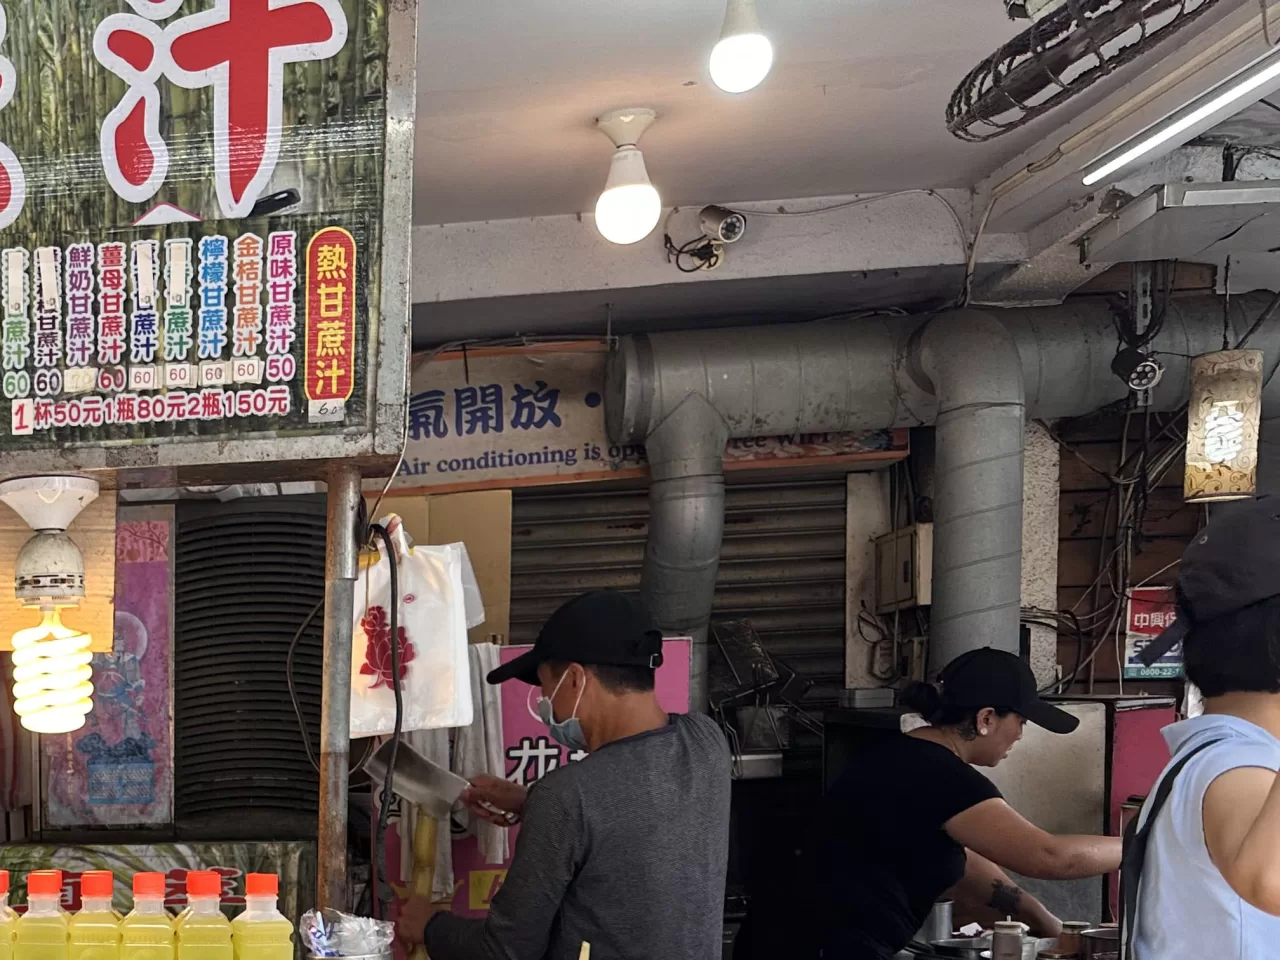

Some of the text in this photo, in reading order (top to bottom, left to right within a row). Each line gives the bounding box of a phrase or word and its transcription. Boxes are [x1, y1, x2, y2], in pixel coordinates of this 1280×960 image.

[69, 245, 92, 363] 鮮奶甘蔗汁
[100, 244, 123, 361] 薑母甘蔗汁
[201, 237, 226, 356] 檸檬甘蔗汁
[236, 235, 261, 353] 金桔甘蔗汁
[269, 233, 294, 351] 原味甘蔗汁
[316, 243, 348, 395] 熱甘蔗汁
[100, 369, 125, 390] 60
[133, 371, 151, 384] 60
[169, 368, 187, 381] 60
[205, 367, 222, 380] 60
[237, 363, 255, 377] 60
[268, 357, 293, 378] 50
[4, 373, 29, 395] 60
[36, 373, 60, 395] 60
[410, 381, 562, 441] 氣開放
[398, 457, 431, 479] Air
[436, 447, 578, 475] conditioning
[584, 444, 601, 462] is
